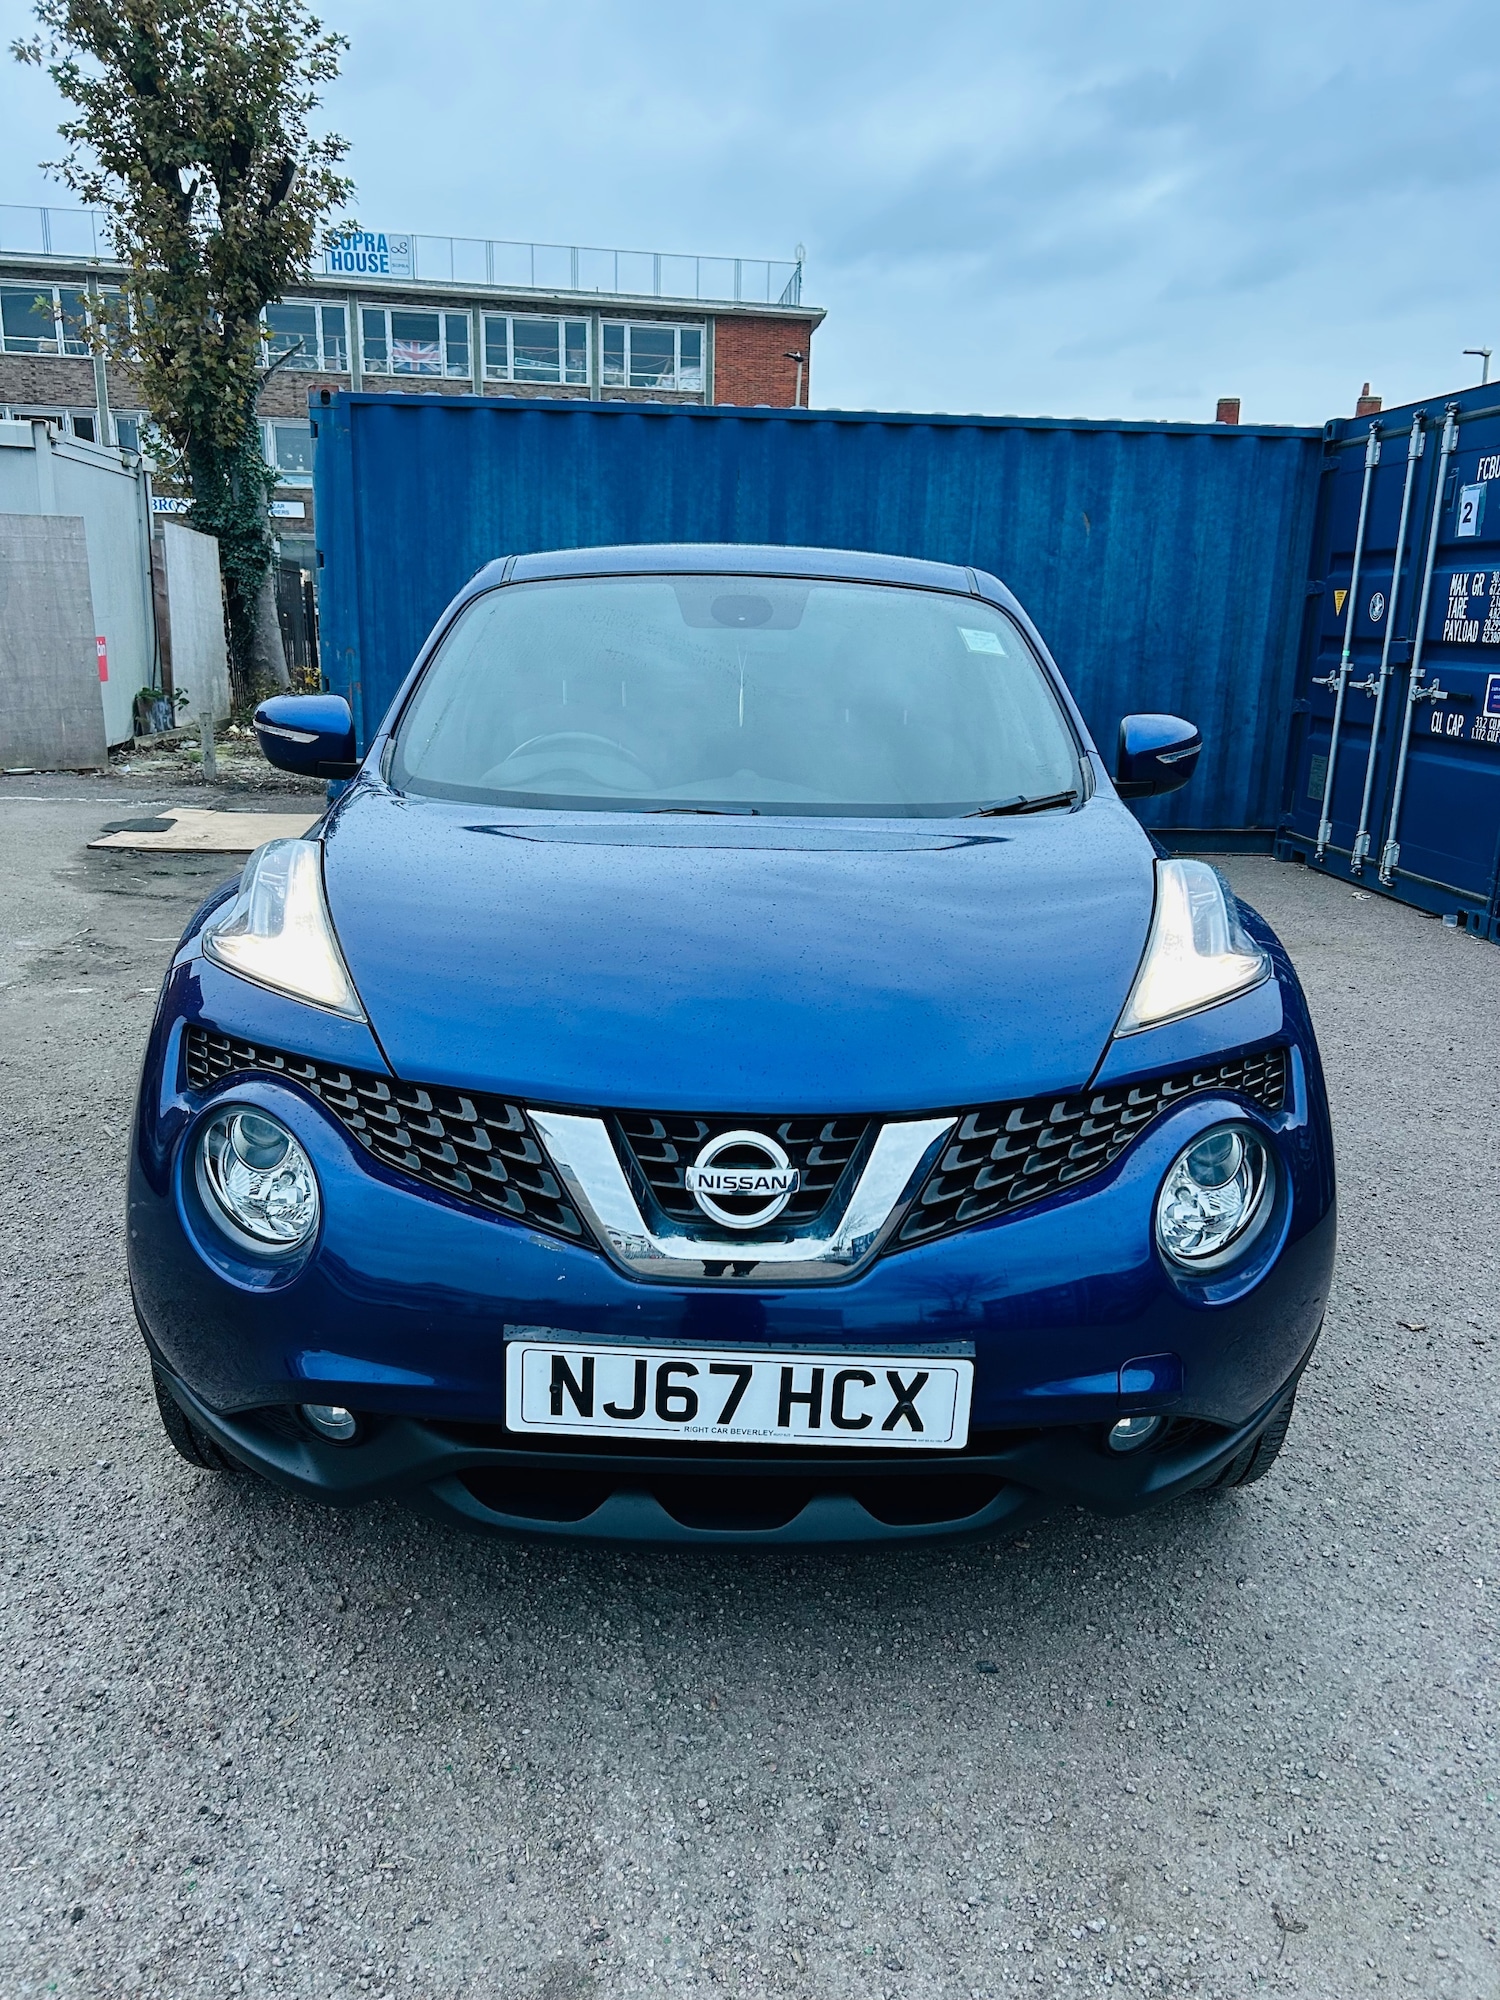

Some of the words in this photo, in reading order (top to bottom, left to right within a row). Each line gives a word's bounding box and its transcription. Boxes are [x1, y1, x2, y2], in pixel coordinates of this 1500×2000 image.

[331, 251, 390, 274] HOUSE
[1462, 501, 1473, 524] 2
[1447, 597, 1469, 619] TARE
[1443, 620, 1479, 643] PAYLOAD
[1431, 711, 1443, 733] CU.
[1446, 713, 1464, 737] CAP.
[698, 1174, 787, 1190] NISSAN
[550, 1355, 753, 1424] NJ67
[777, 1366, 929, 1432] HCX
[730, 1428, 774, 1437] BEVERLEY
